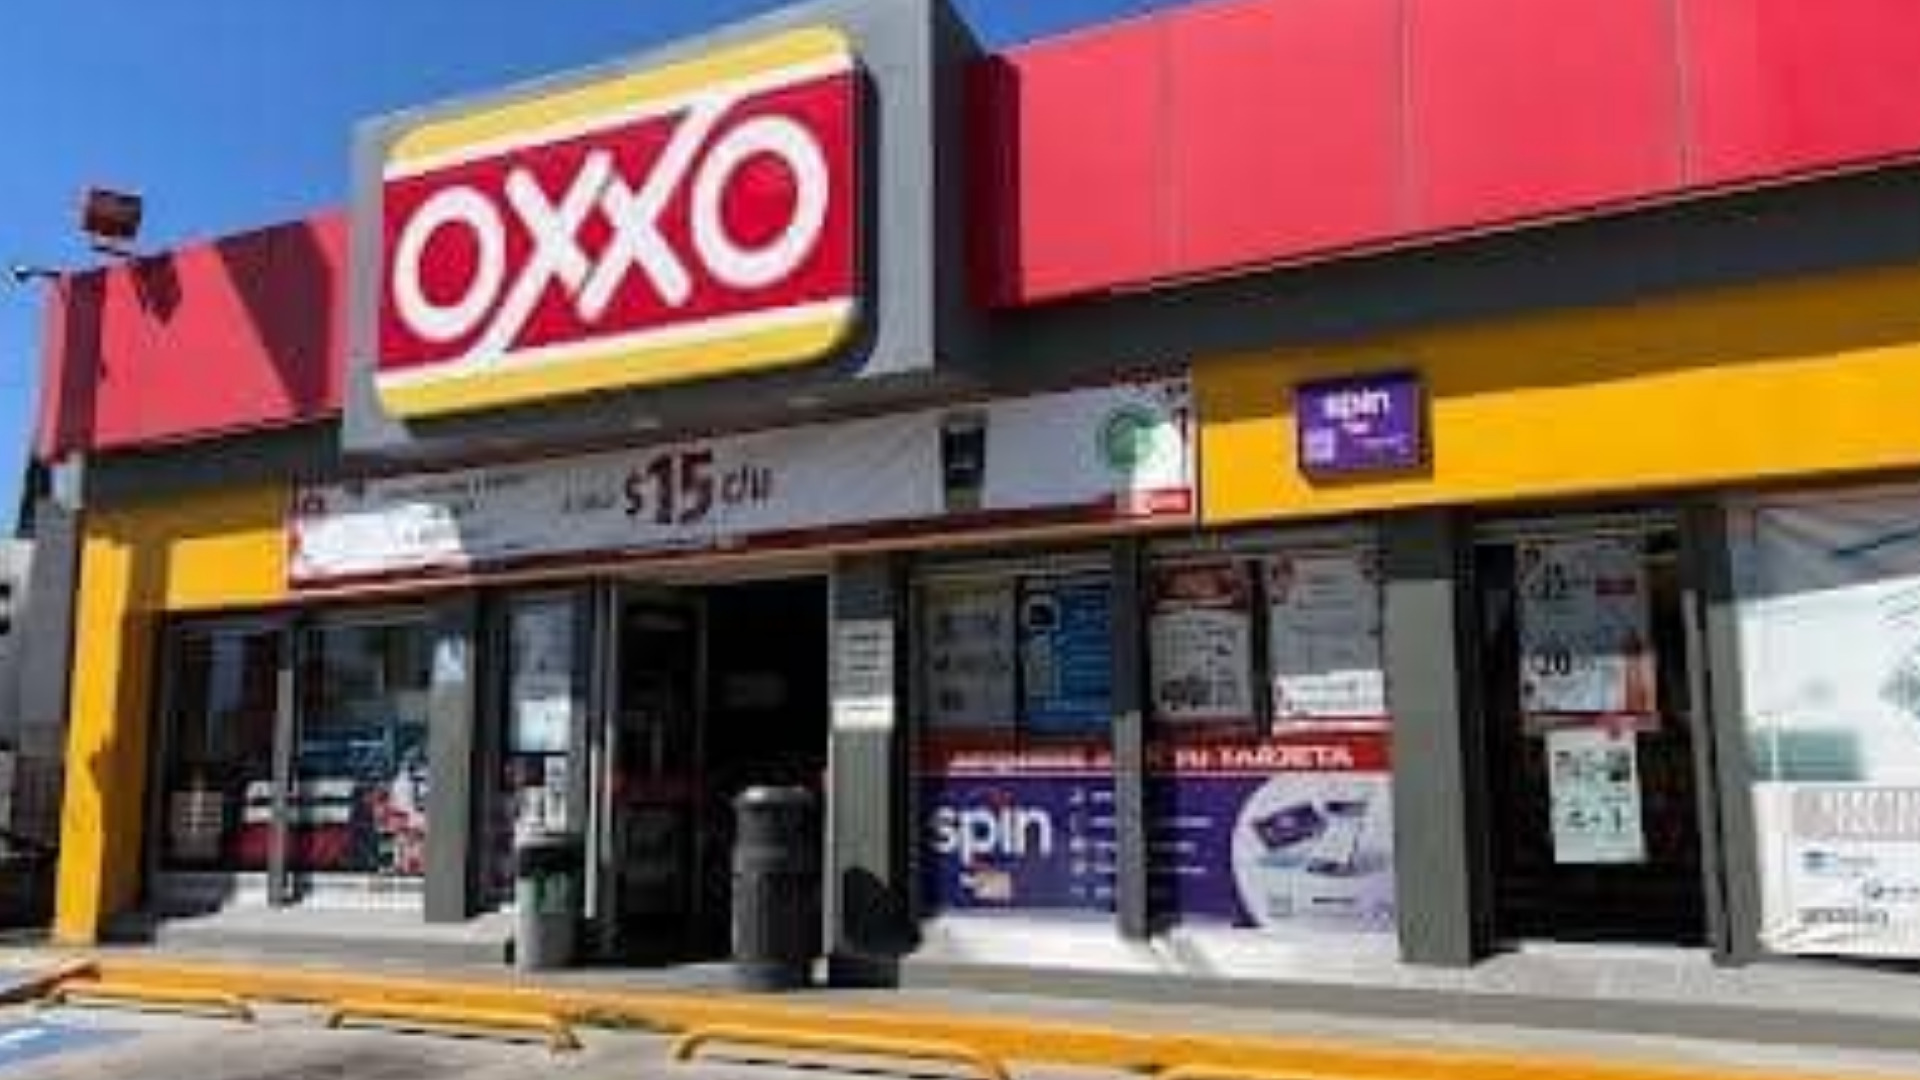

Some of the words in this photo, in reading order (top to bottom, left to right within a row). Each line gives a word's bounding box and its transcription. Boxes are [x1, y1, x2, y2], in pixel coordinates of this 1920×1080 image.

[393, 97, 828, 363] OXXO
[624, 448, 713, 525] $15
[1217, 743, 1355, 770] TARJETA
[932, 800, 1053, 866] spin
